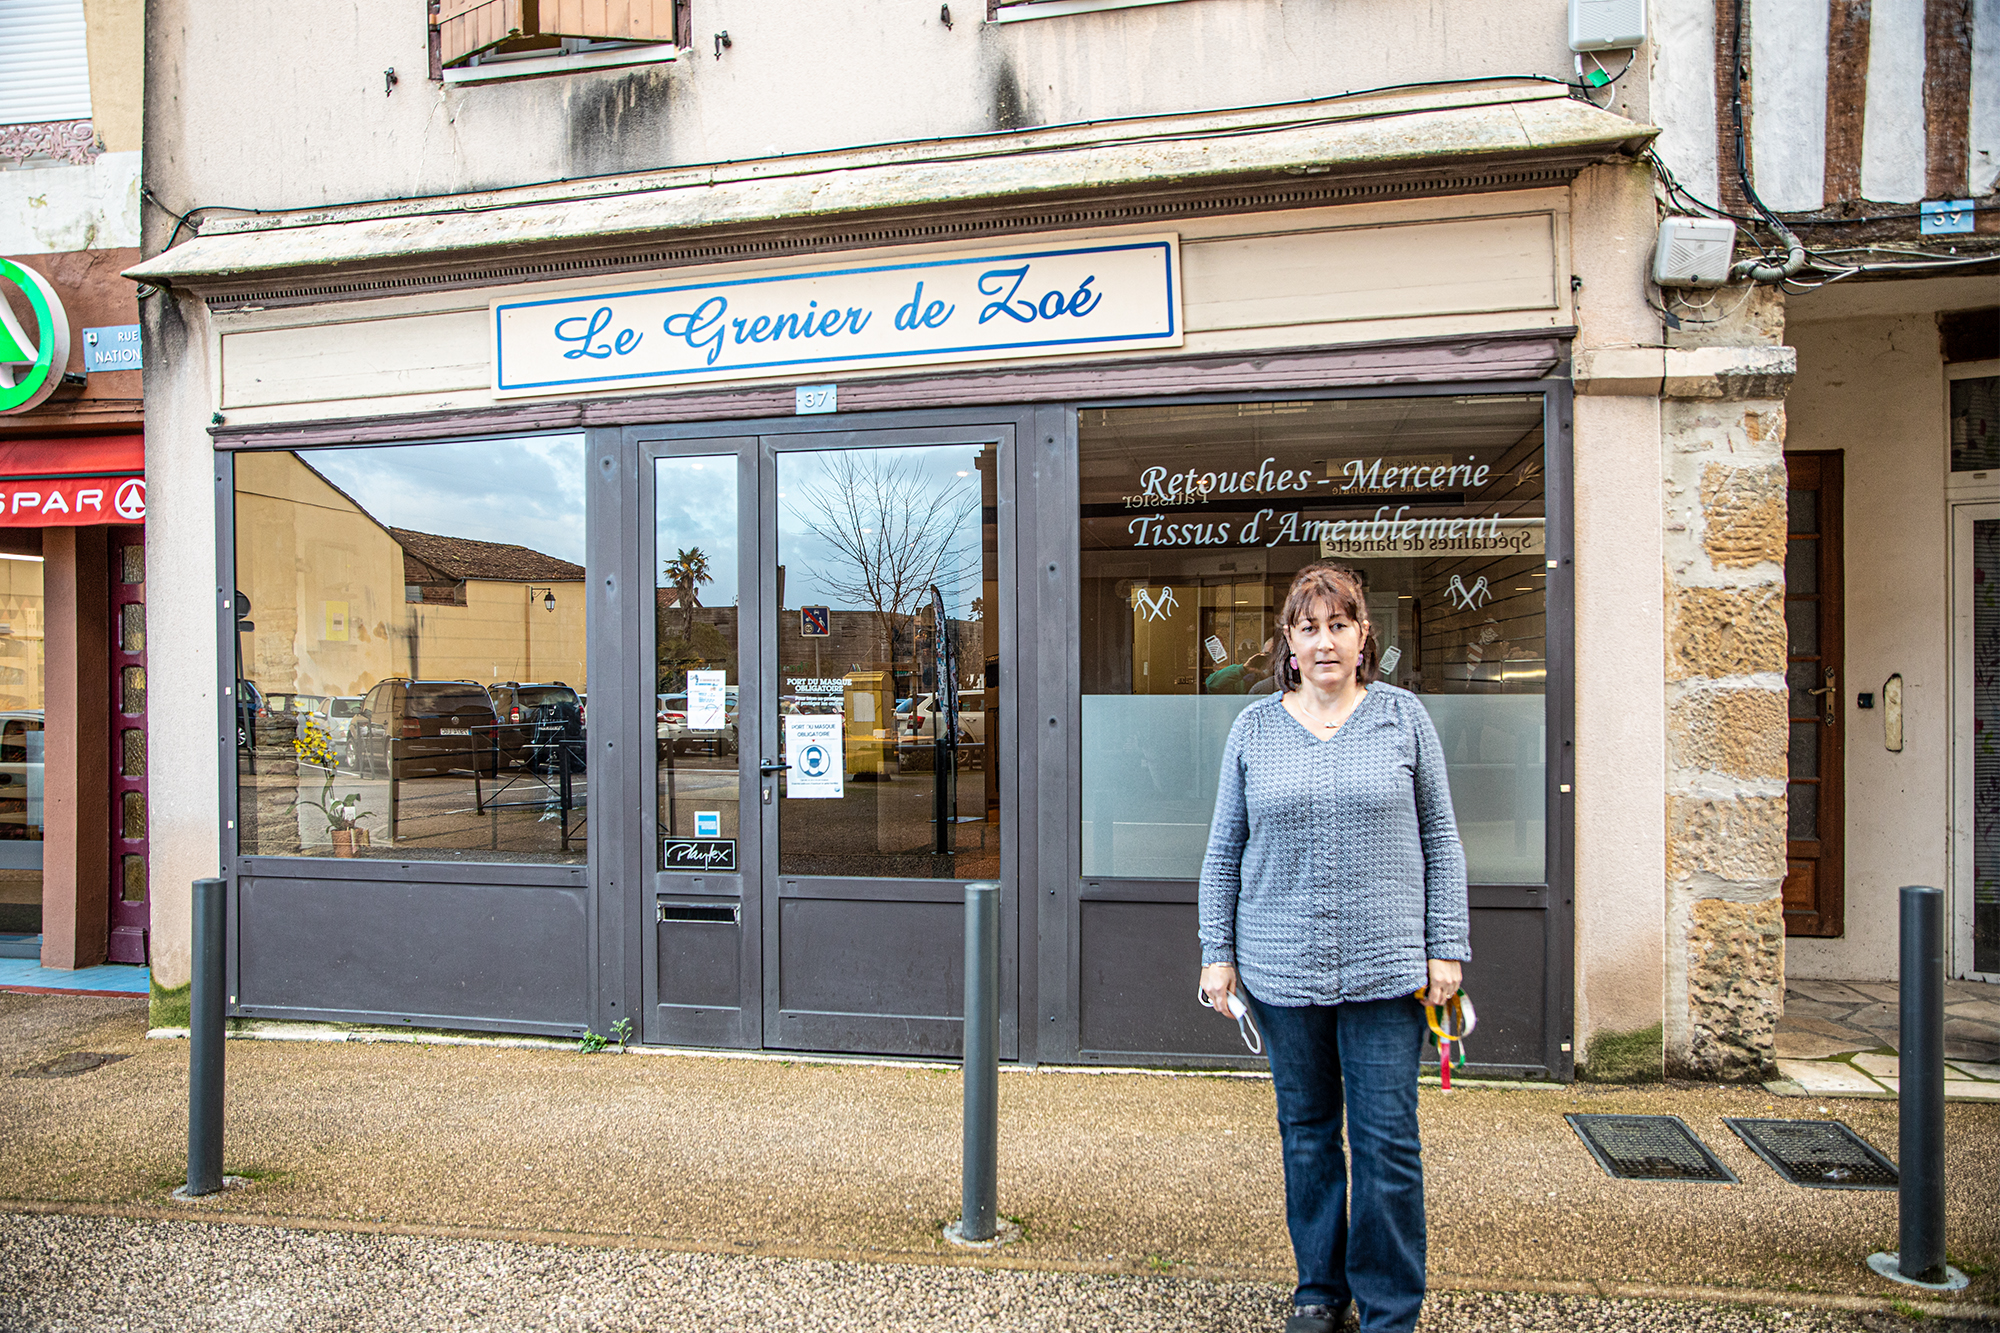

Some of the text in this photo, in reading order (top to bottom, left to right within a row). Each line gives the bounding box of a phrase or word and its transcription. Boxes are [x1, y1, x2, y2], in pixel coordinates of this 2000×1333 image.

[1932, 208, 1963, 227] 39
[554, 263, 1102, 366] Le Grenier de Zoé
[118, 331, 139, 342] RUE
[95, 348, 143, 364] NATION
[804, 391, 828, 408] 37
[1140, 457, 1312, 501] Retouches
[1341, 455, 1490, 491] Mercerie
[0, 489, 104, 514] PAR
[1128, 513, 1231, 547] Tissus
[786, 678, 806, 686] PORT
[819, 678, 853, 686] MASQUE
